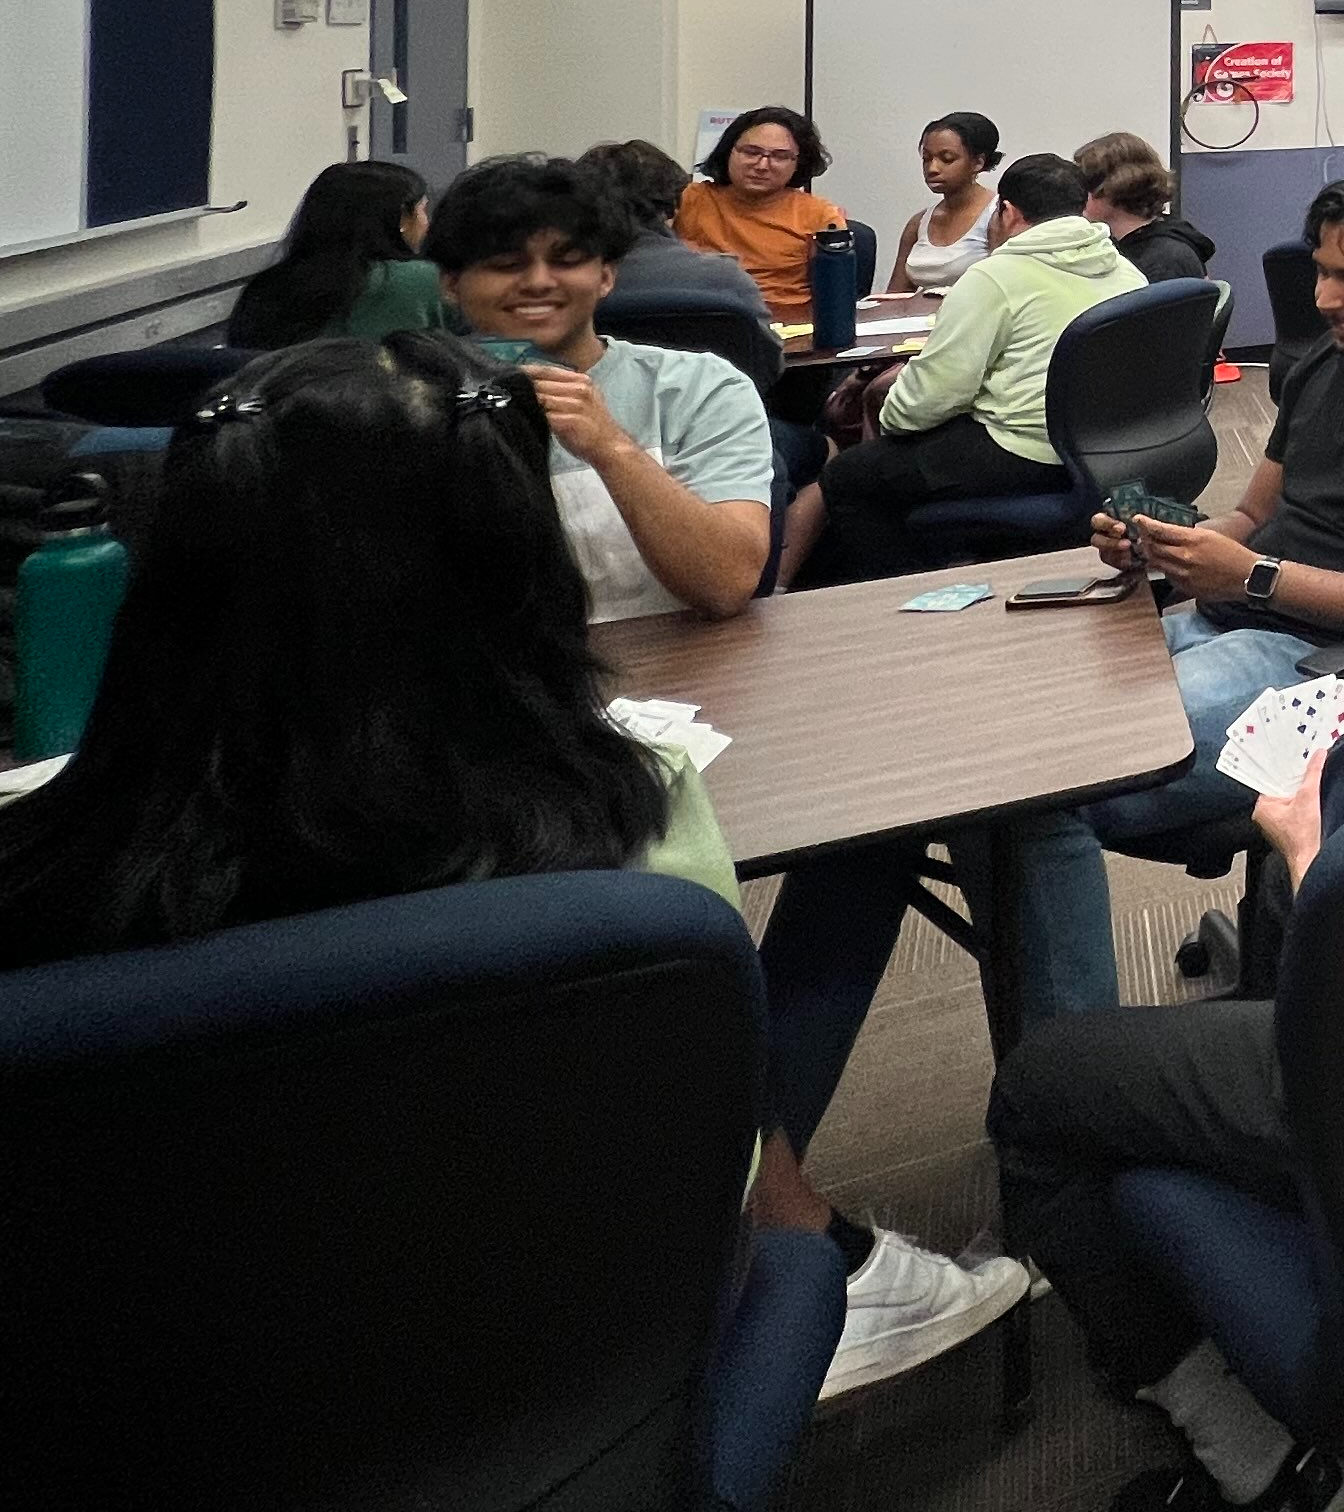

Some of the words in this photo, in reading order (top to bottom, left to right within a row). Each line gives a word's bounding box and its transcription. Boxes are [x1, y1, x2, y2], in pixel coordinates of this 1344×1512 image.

[1224, 56, 1268, 66] Creation
[1270, 55, 1282, 66] of
[1252, 68, 1291, 79] Society
